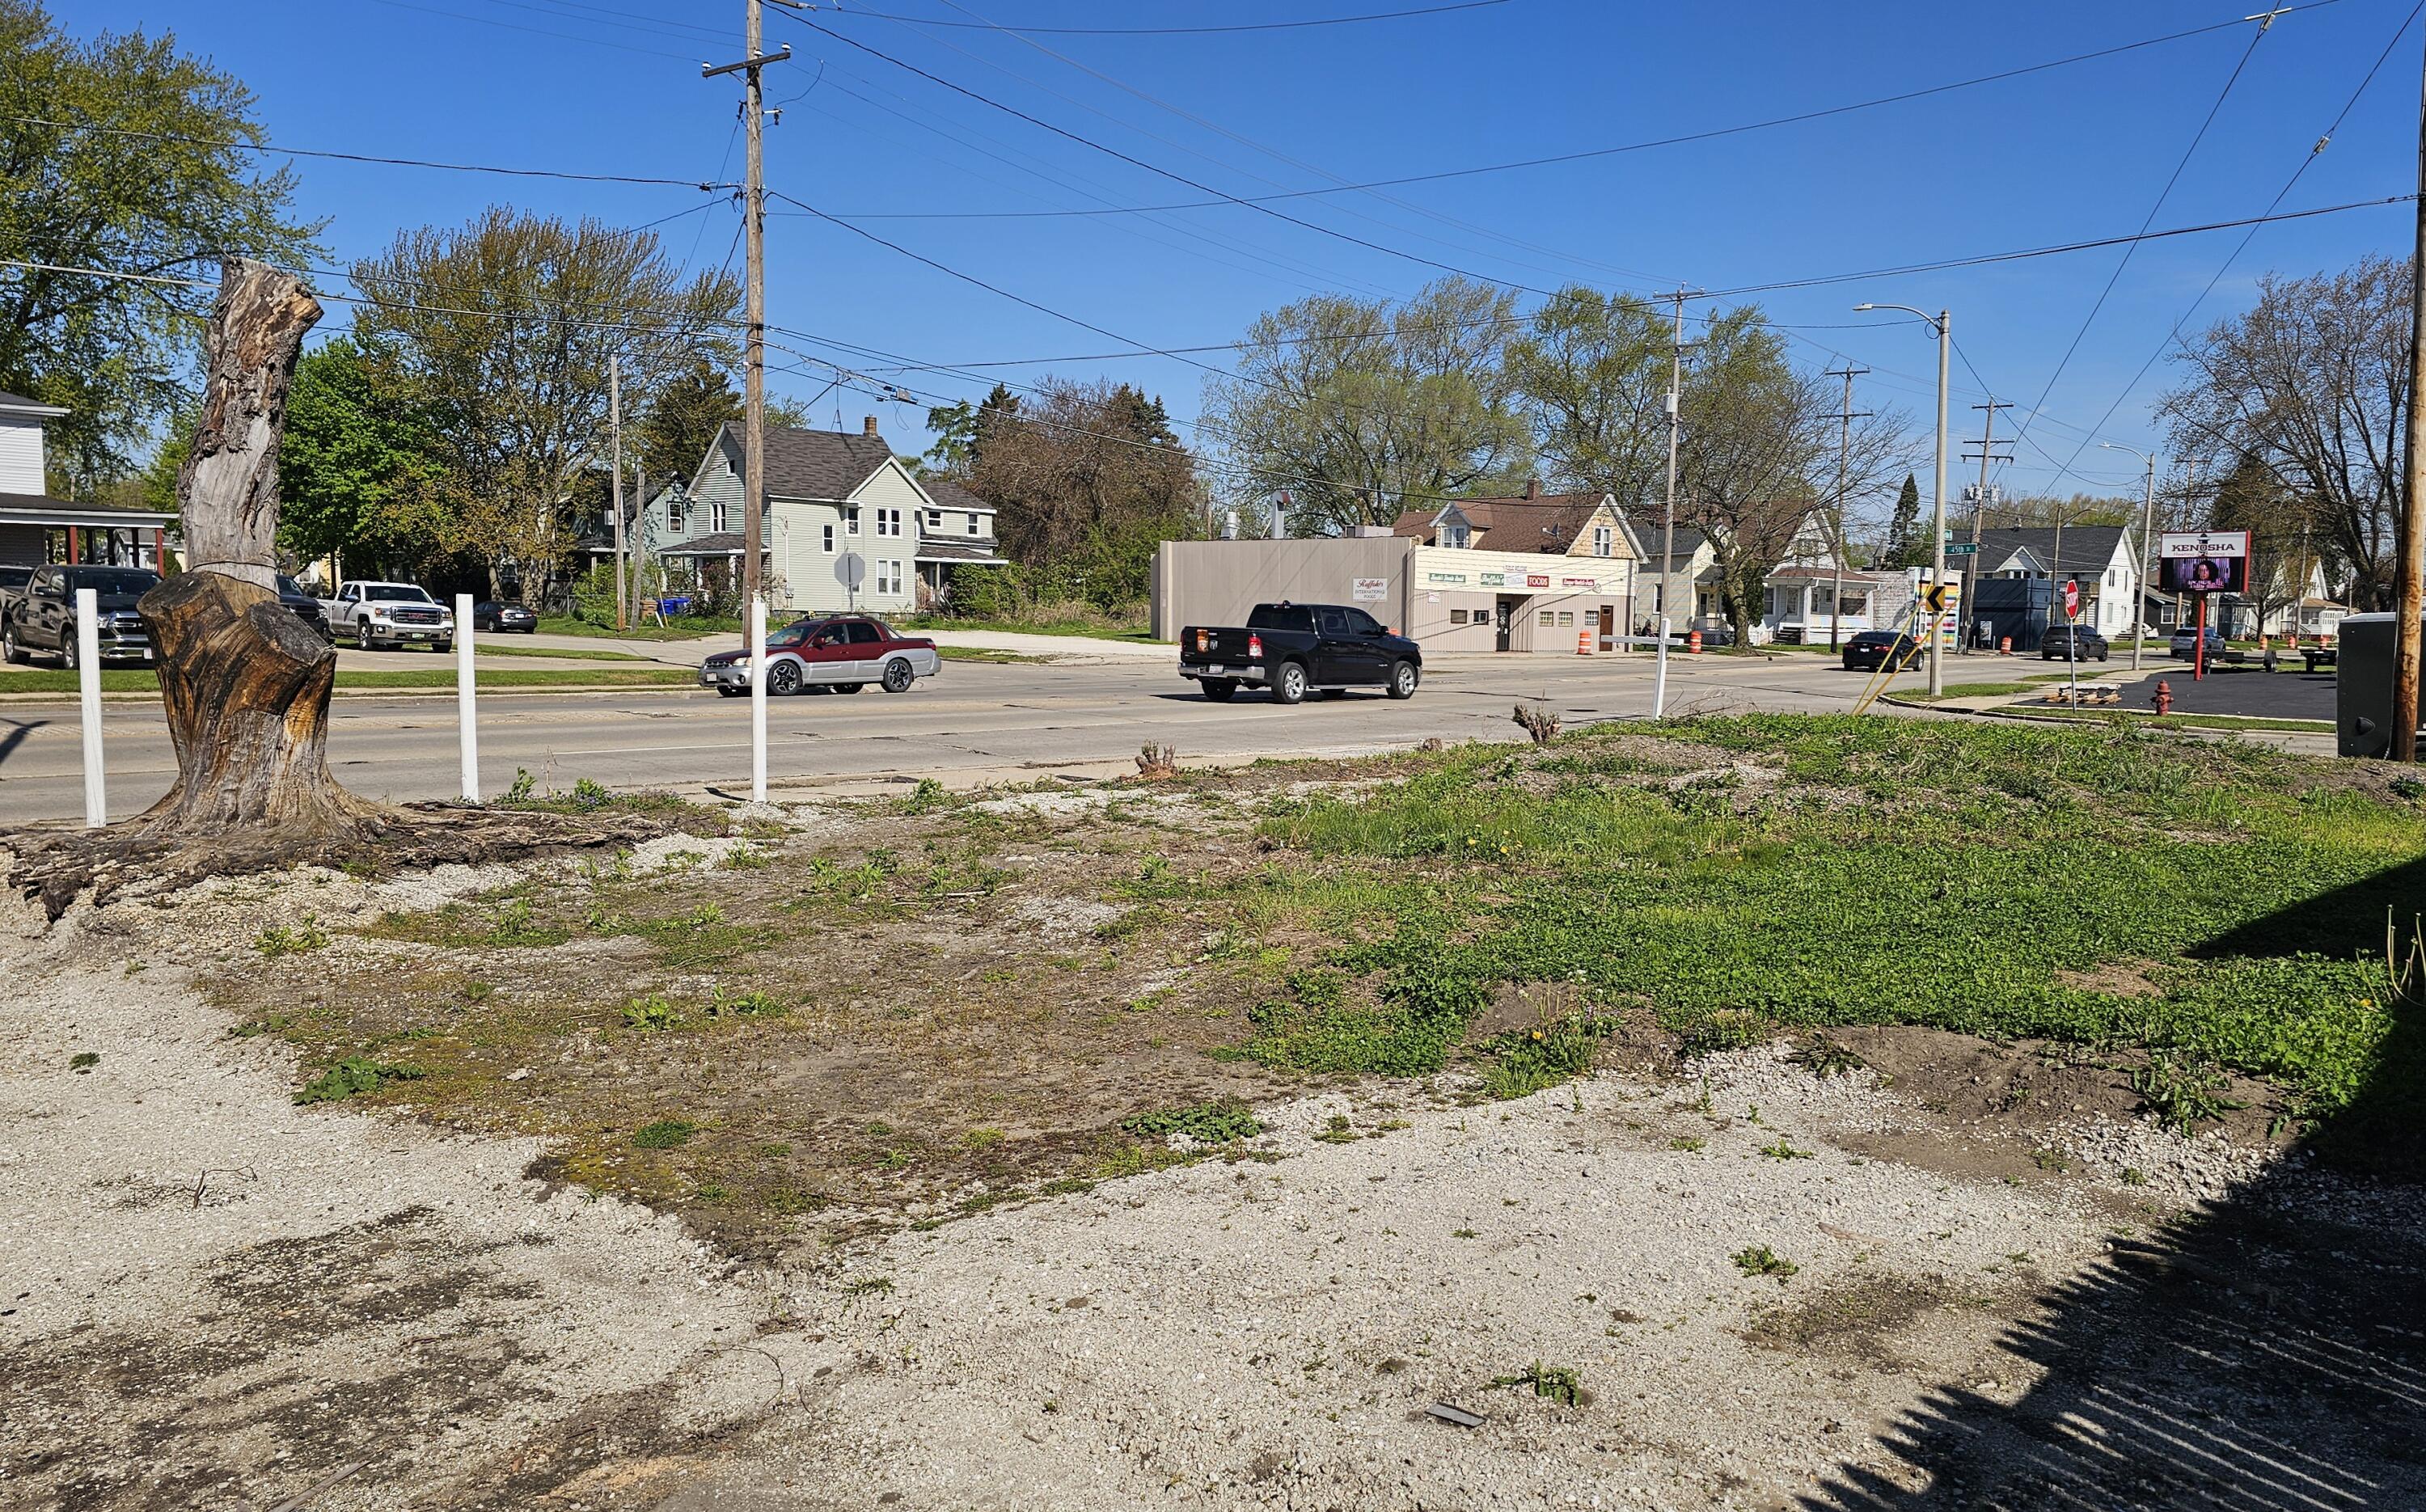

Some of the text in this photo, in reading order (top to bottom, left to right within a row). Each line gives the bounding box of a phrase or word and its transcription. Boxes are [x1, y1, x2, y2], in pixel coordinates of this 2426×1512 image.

[2172, 543, 2235, 551] KENOSHA
[1528, 577, 1548, 585] FOODS
[2066, 592, 2077, 608] STOP
